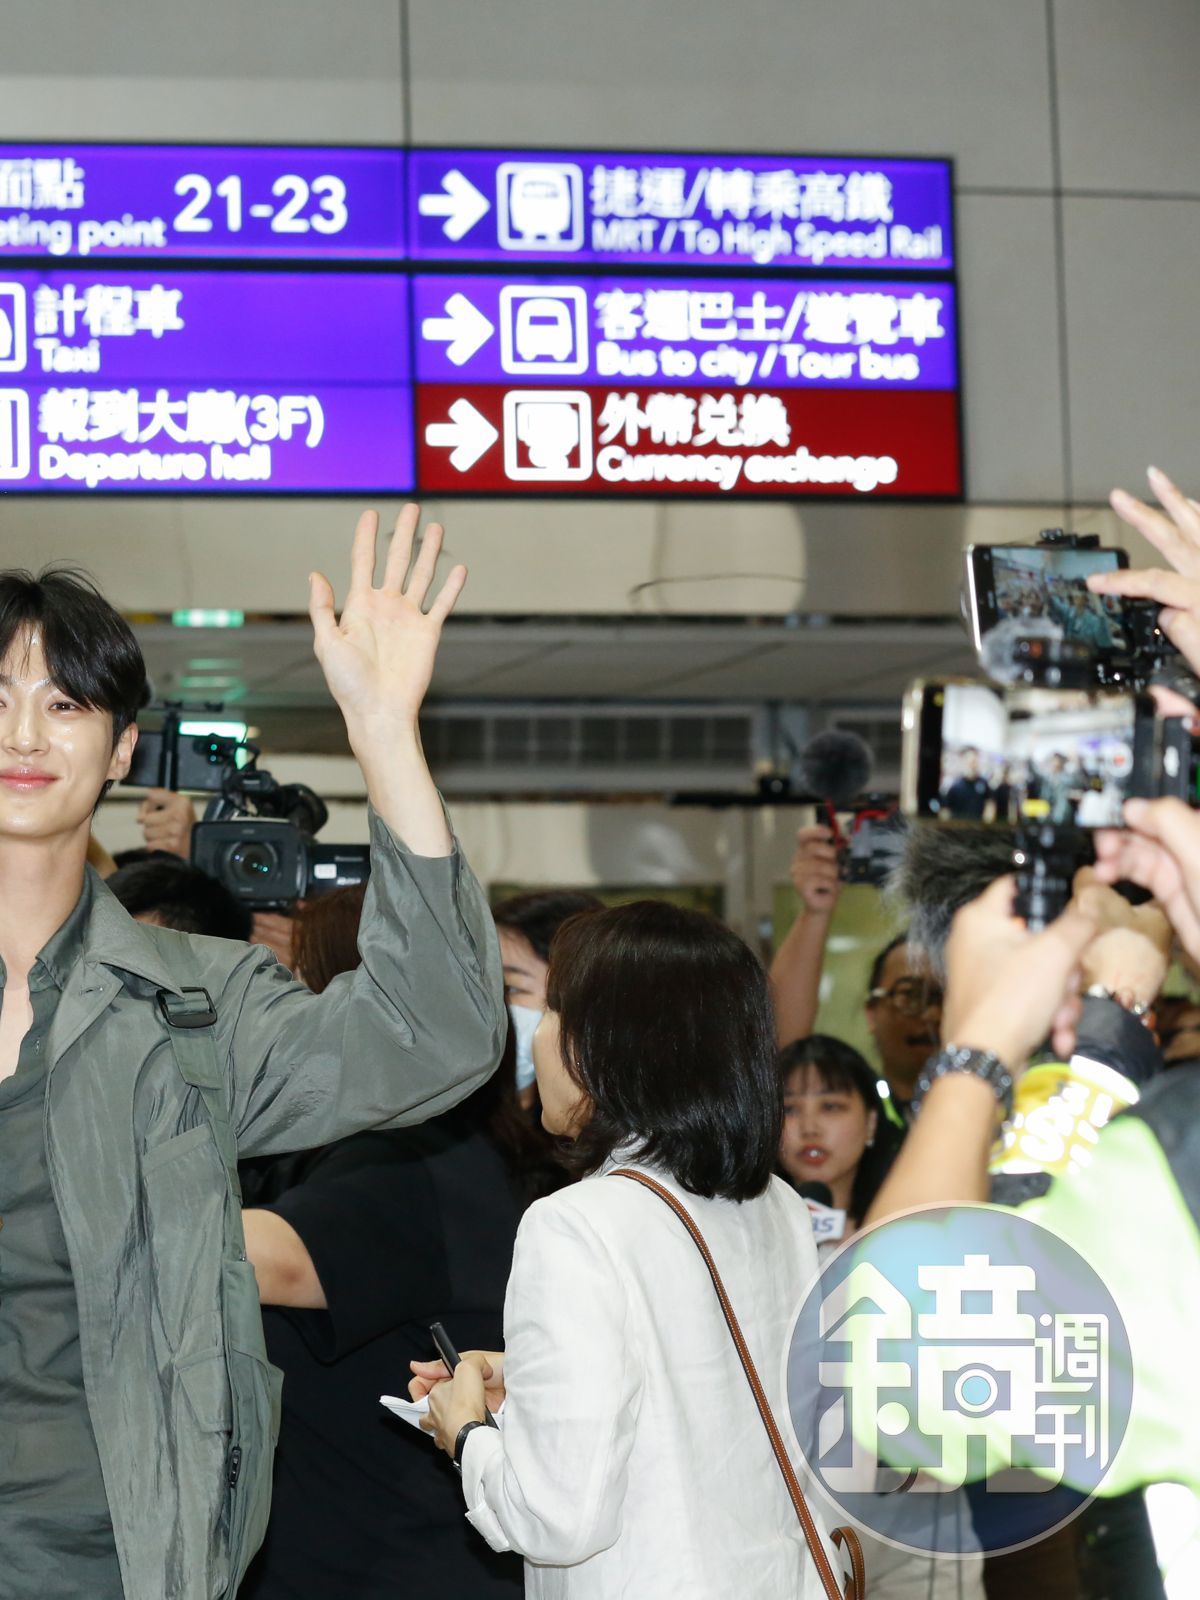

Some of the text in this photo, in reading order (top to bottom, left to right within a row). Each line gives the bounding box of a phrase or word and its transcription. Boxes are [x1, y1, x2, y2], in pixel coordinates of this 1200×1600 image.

[173, 173, 348, 234] 21-23
[77, 212, 167, 256] point
[722, 221, 793, 264] High
[794, 223, 888, 265] Speed
[890, 224, 943, 259] Rail
[33, 283, 184, 338] 計程車
[33, 337, 100, 373] Taxi
[596, 340, 658, 376] Bus
[659, 346, 697, 377] to
[699, 343, 757, 386] city
[778, 343, 857, 380] Tour
[859, 343, 921, 380] bus
[597, 392, 791, 447] 外幣兌換
[37, 444, 272, 488] Departure hall
[596, 445, 898, 491] Currency exchange
